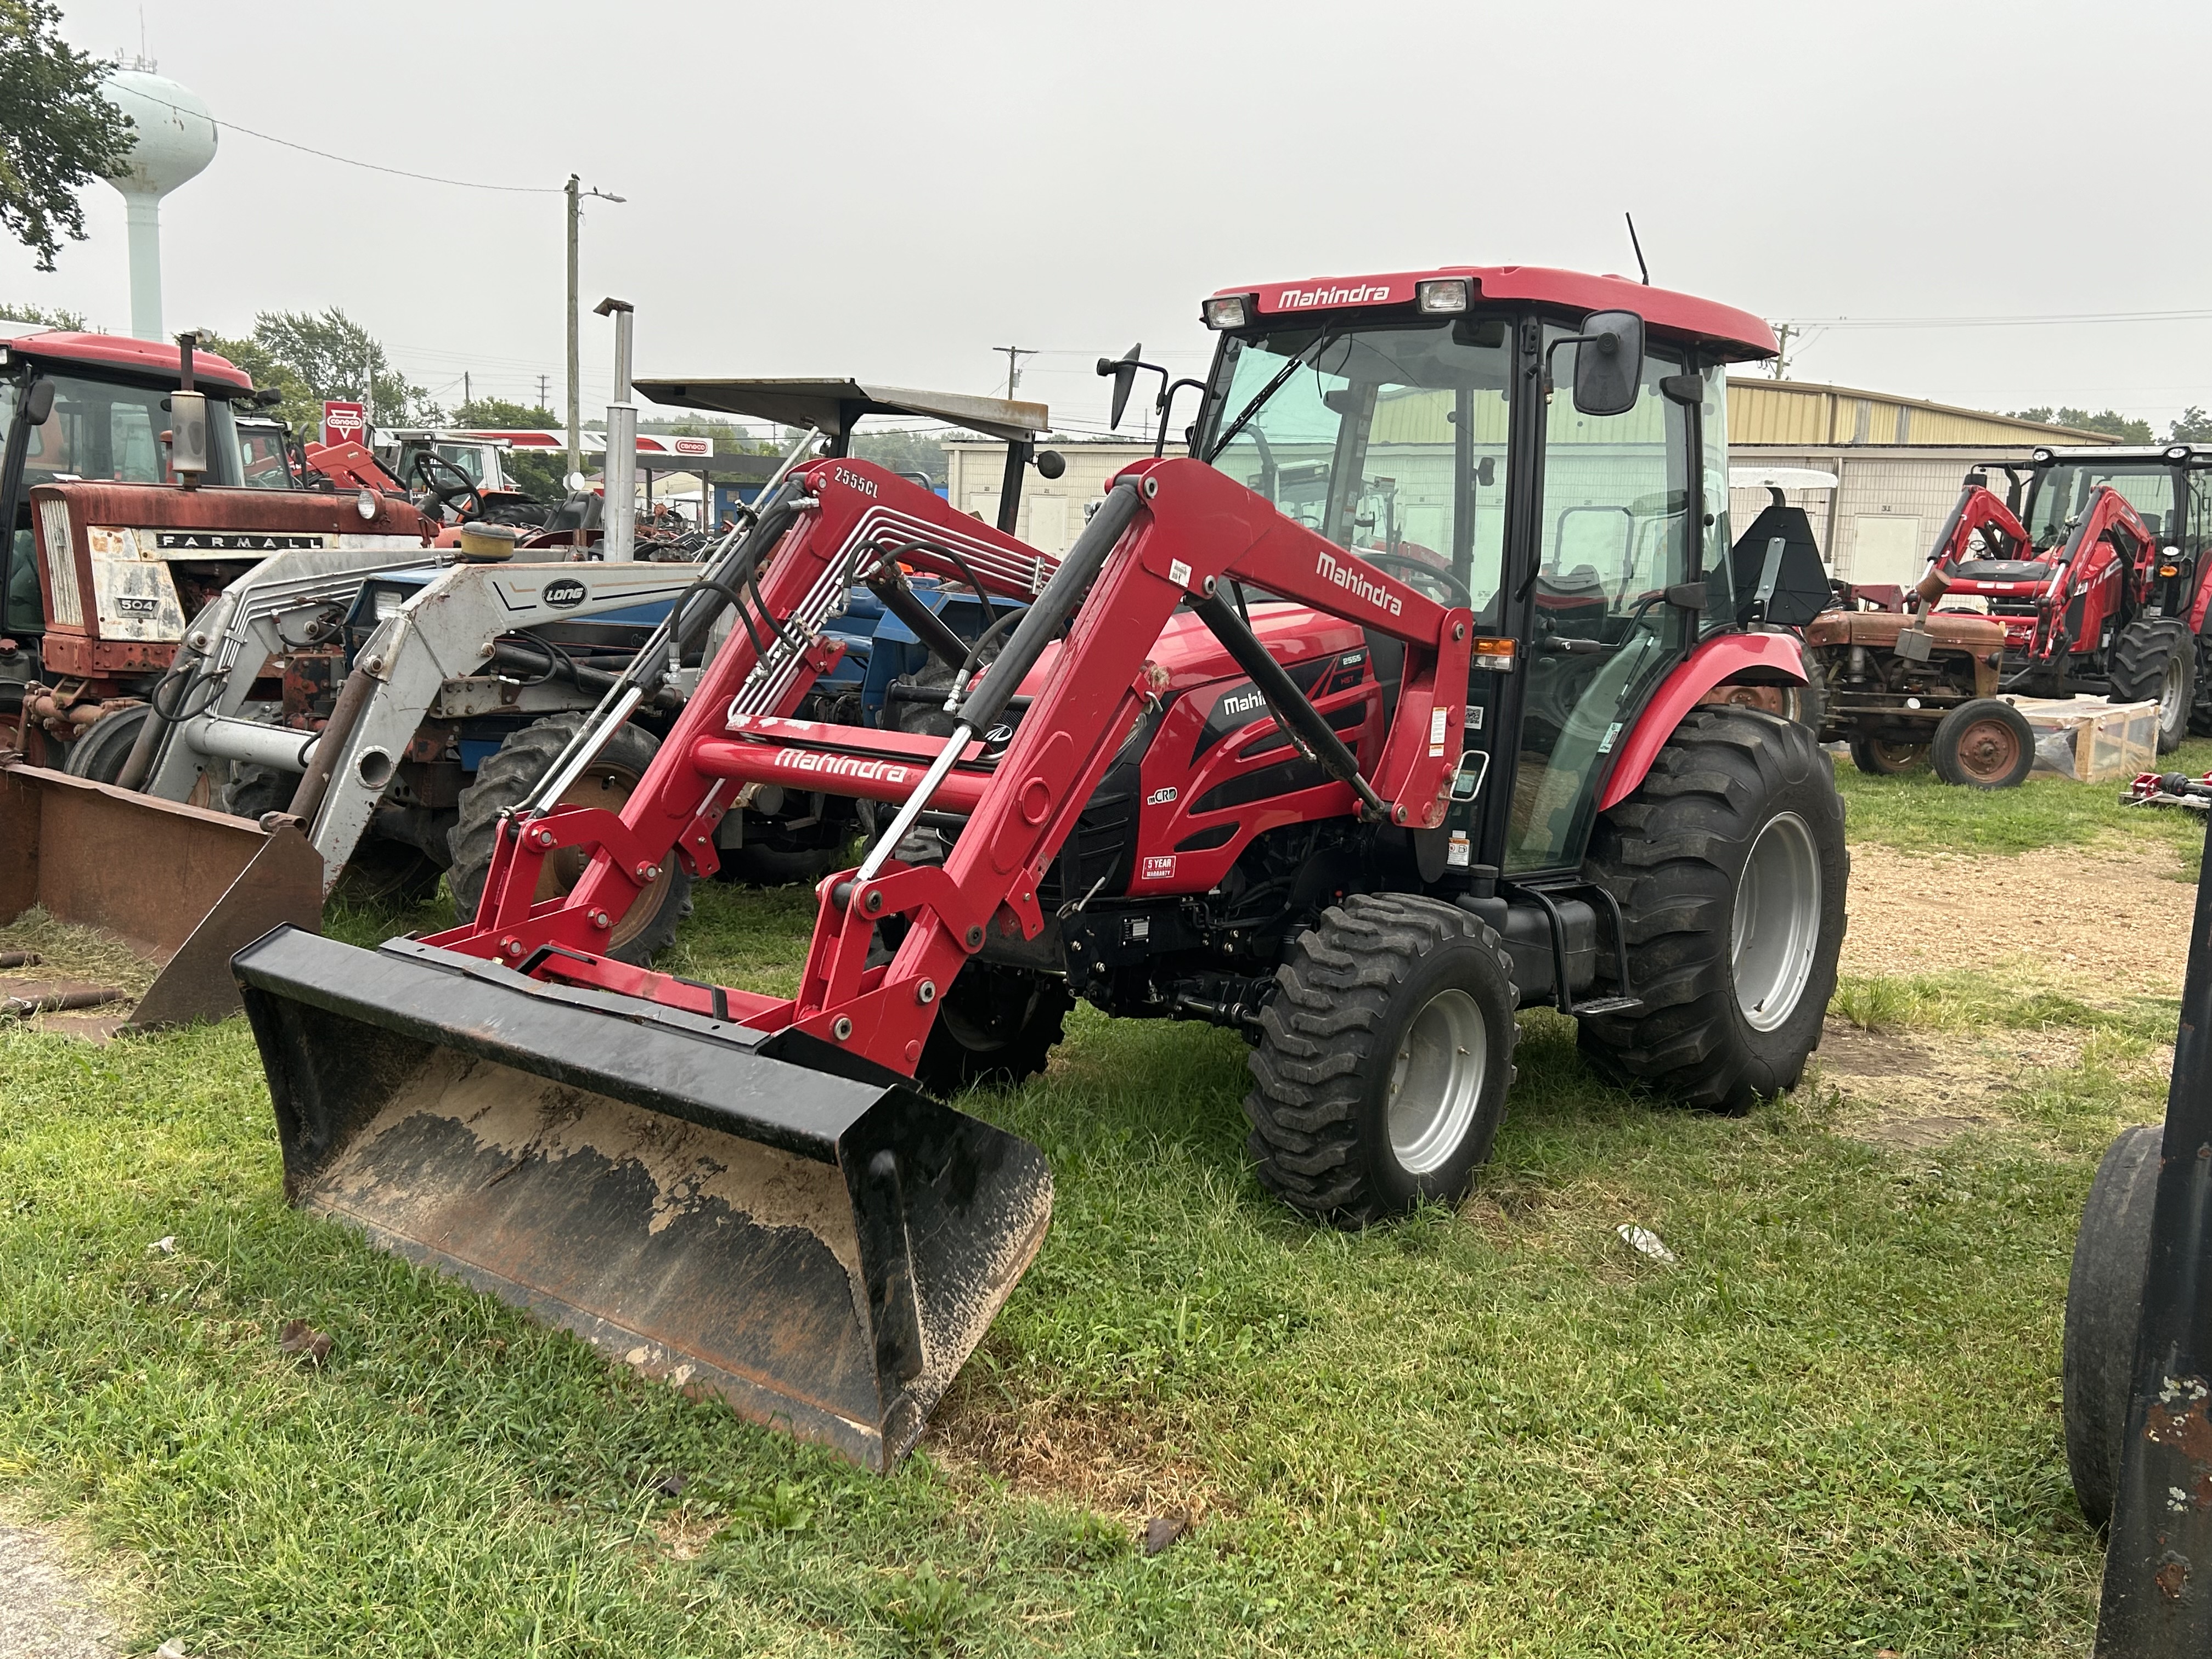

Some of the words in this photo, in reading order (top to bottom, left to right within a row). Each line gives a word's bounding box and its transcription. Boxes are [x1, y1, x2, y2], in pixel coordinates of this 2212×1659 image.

[1278, 284, 1390, 309] Mahindra
[834, 466, 878, 499] 2555CL
[163, 535, 323, 549] FARMALL
[1316, 551, 1402, 617] Mahindra
[546, 588, 584, 601] LONG
[121, 600, 154, 610] 504
[1342, 654, 1361, 665] 2555
[774, 748, 909, 783] Mahindra
[1147, 859, 1153, 868] 5
[1154, 859, 1172, 868] YEAR
